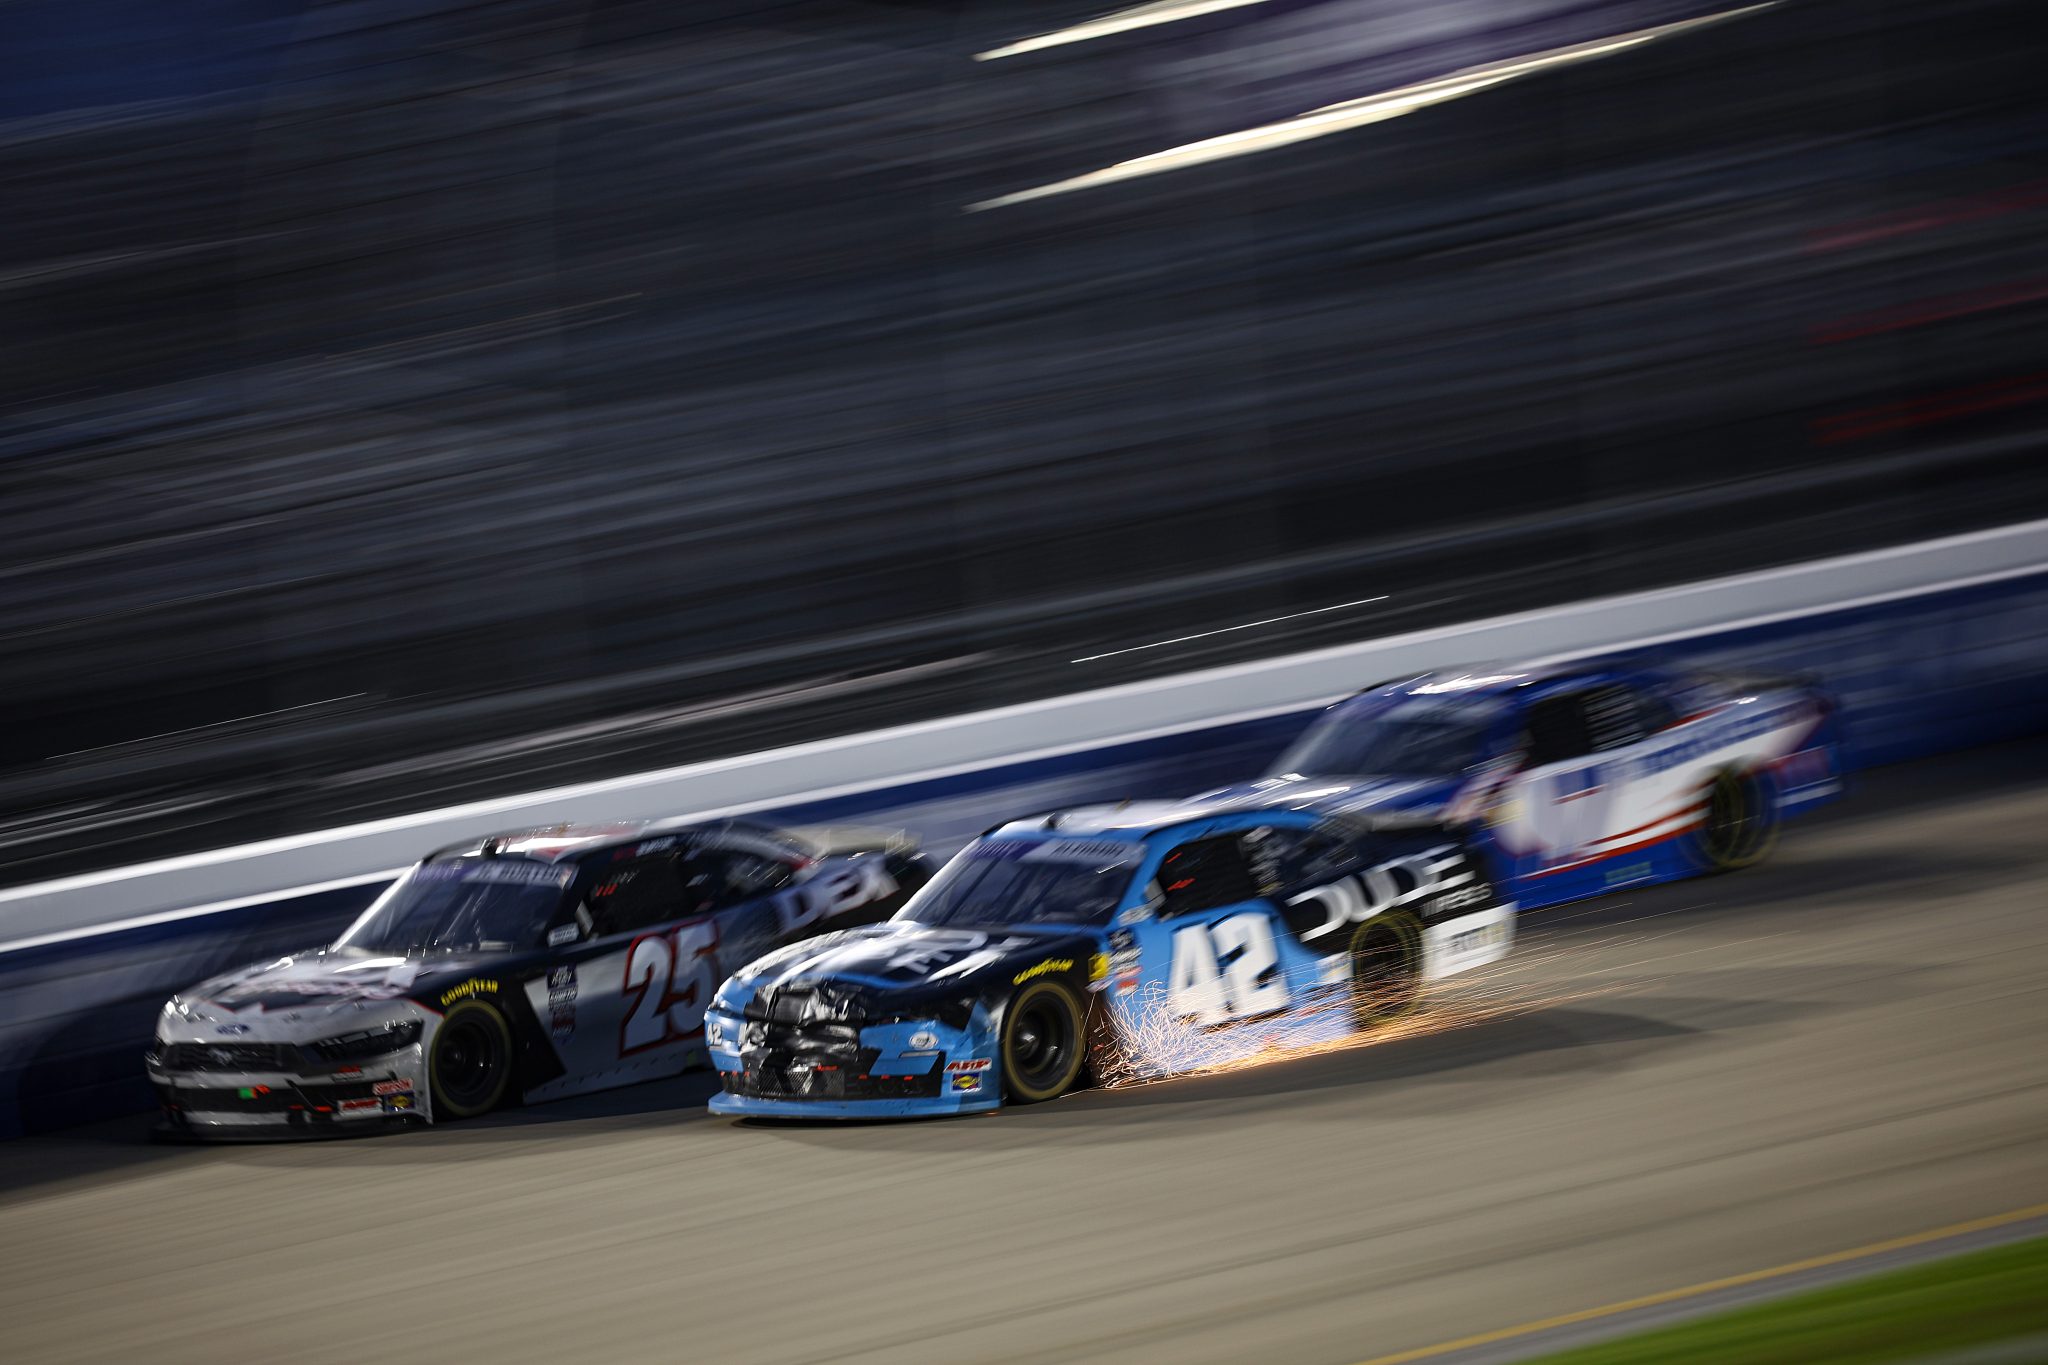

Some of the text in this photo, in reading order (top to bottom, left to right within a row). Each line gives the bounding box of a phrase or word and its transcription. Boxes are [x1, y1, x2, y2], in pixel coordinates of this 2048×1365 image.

[441, 977, 498, 1006] GOODYEAR
[620, 917, 719, 1056] 25
[1168, 911, 1290, 1022] 42
